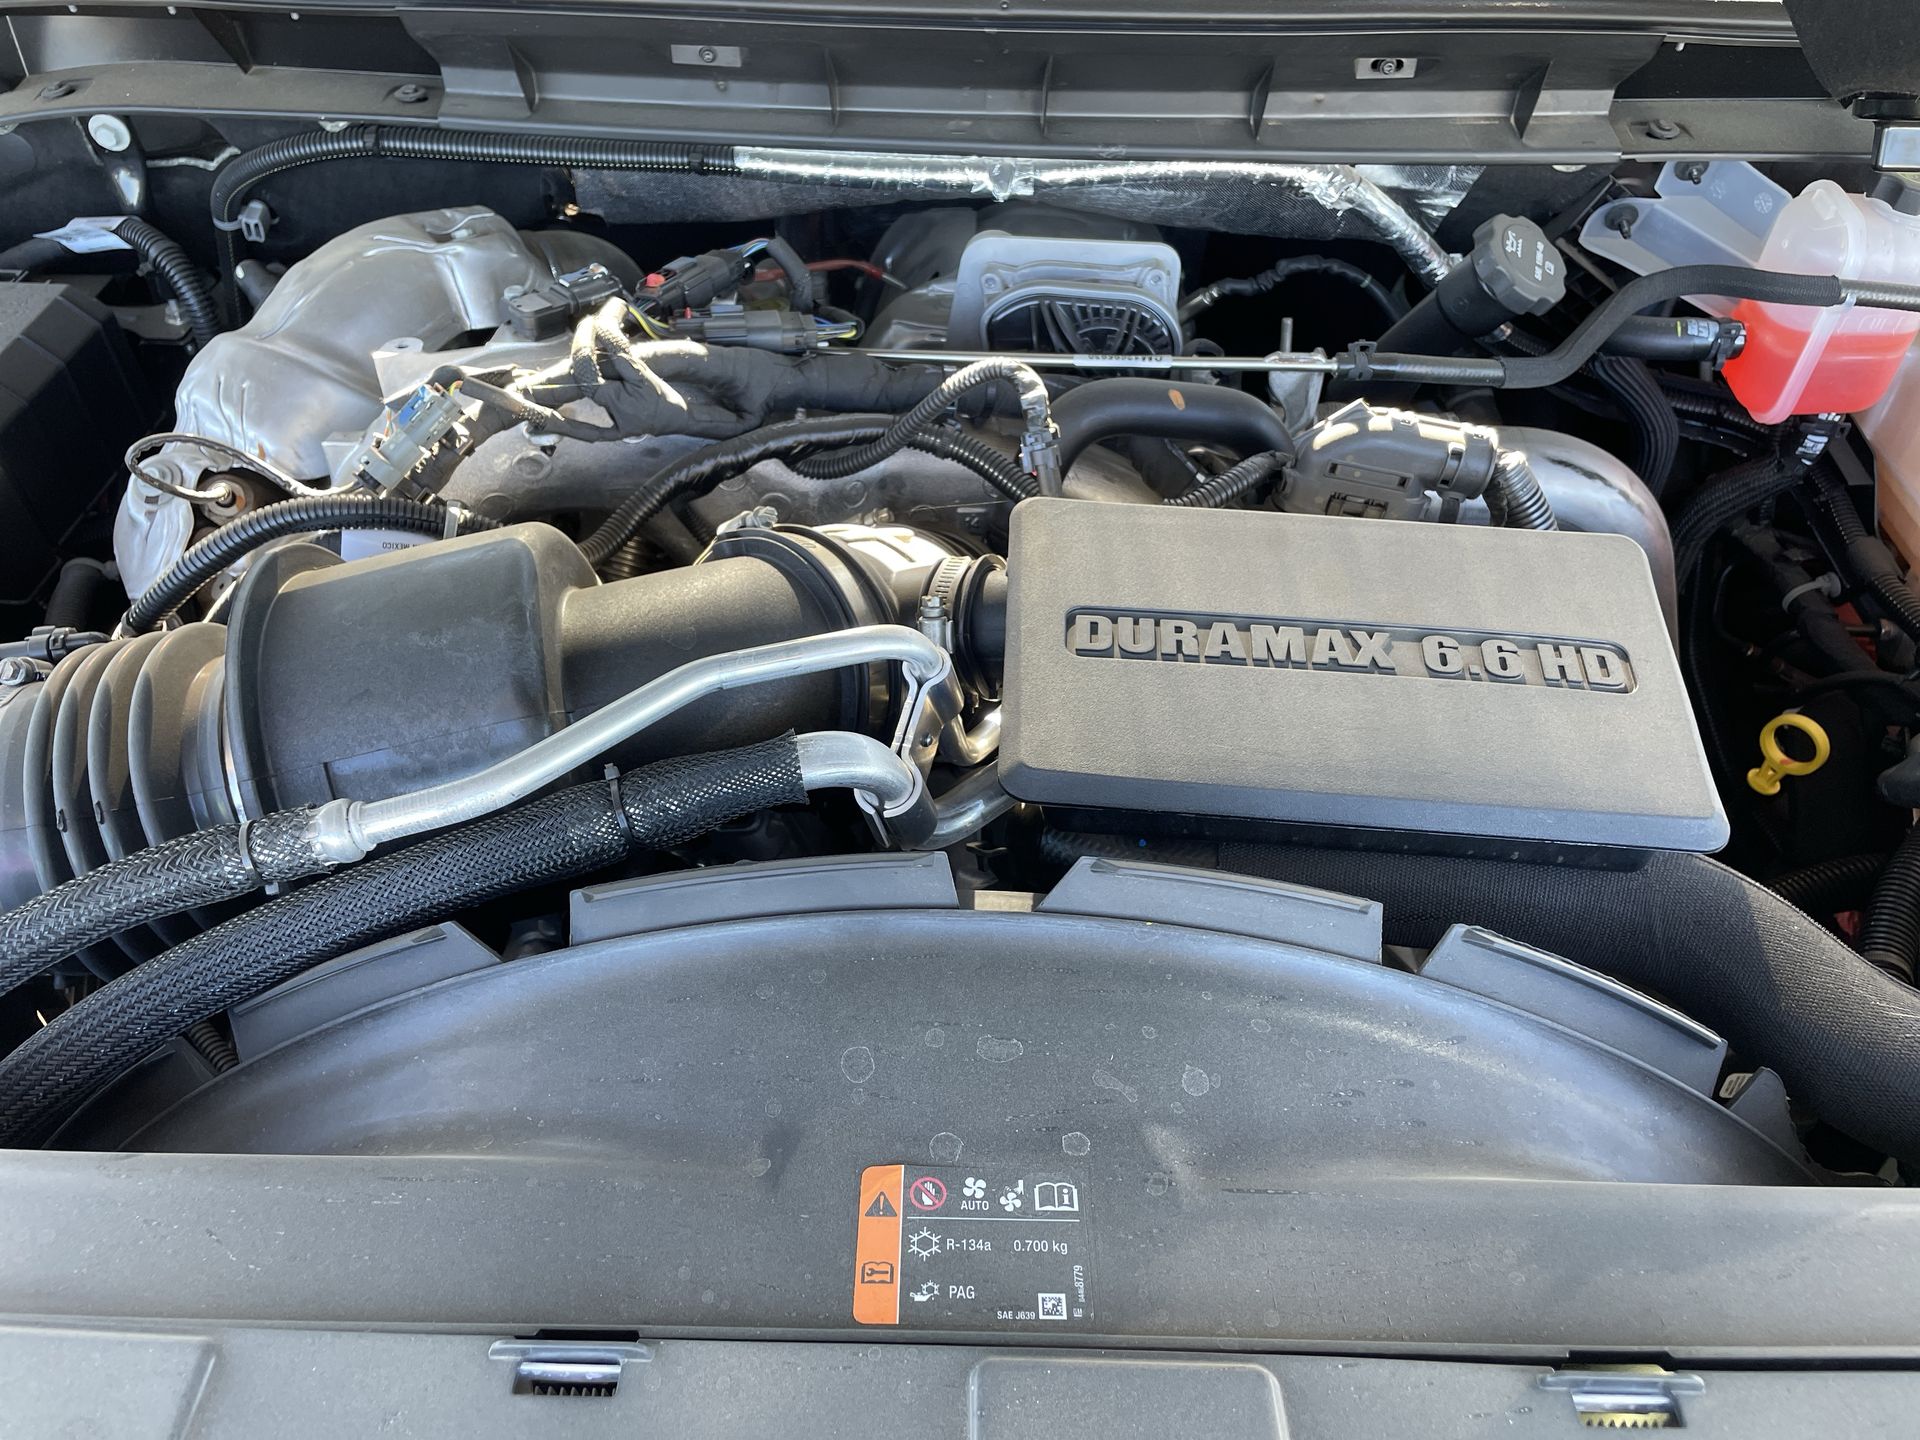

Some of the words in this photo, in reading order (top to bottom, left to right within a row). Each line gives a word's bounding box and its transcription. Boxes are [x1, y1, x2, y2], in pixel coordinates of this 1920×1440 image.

[1075, 613, 1397, 674] DURAMAX
[1422, 634, 1525, 682] 6.6
[1537, 643, 1630, 690] HD
[961, 1200, 990, 1211] AUTO
[946, 1238, 992, 1251] R-134a
[1013, 1239, 1049, 1252] 0.700
[1052, 1240, 1068, 1255] kg
[949, 1285, 976, 1300] PAG
[997, 1310, 1014, 1320] SAE
[1015, 1311, 1036, 1321] J639
